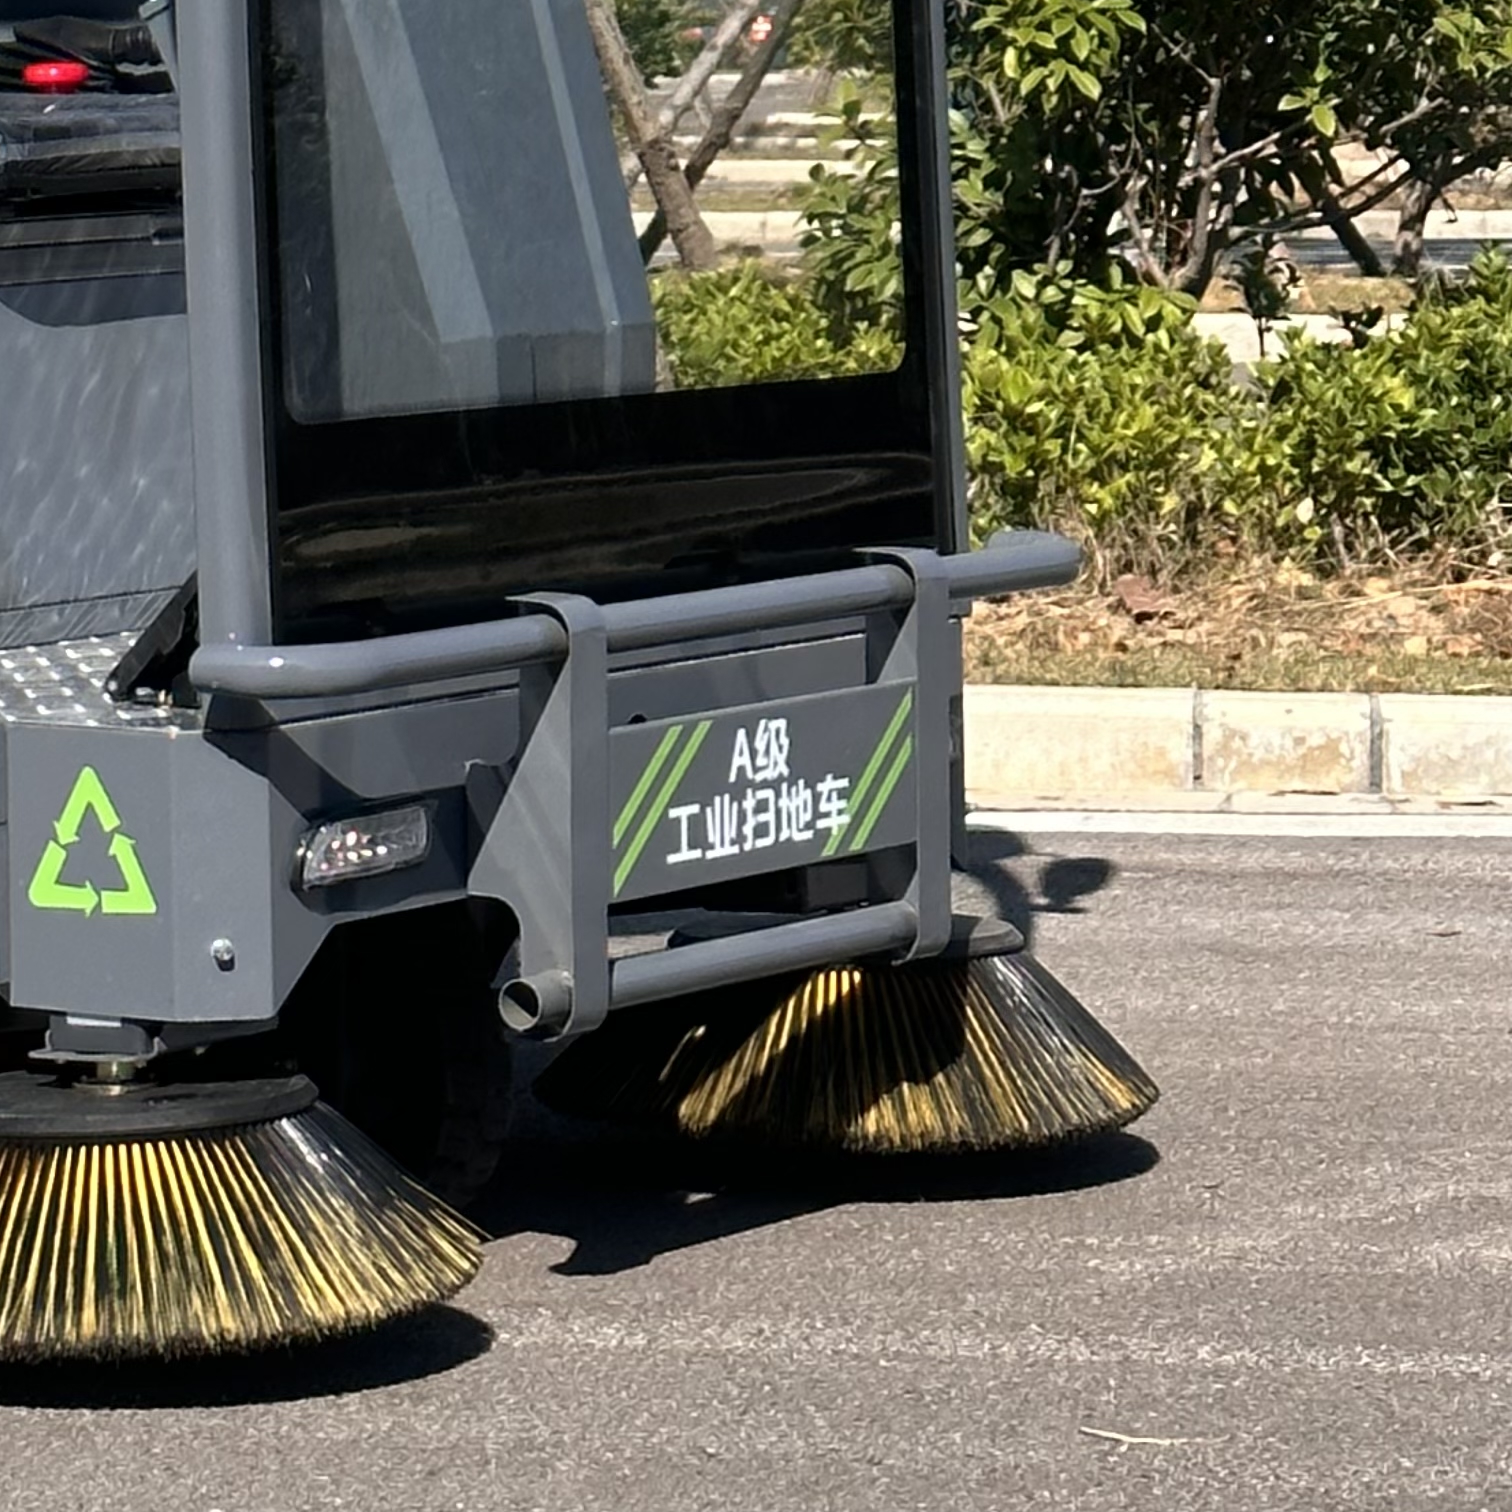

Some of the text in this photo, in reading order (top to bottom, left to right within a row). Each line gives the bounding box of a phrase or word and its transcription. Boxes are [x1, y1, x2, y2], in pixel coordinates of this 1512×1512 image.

[728, 717, 790, 783] A级
[666, 773, 851, 864] 工业扫地车
